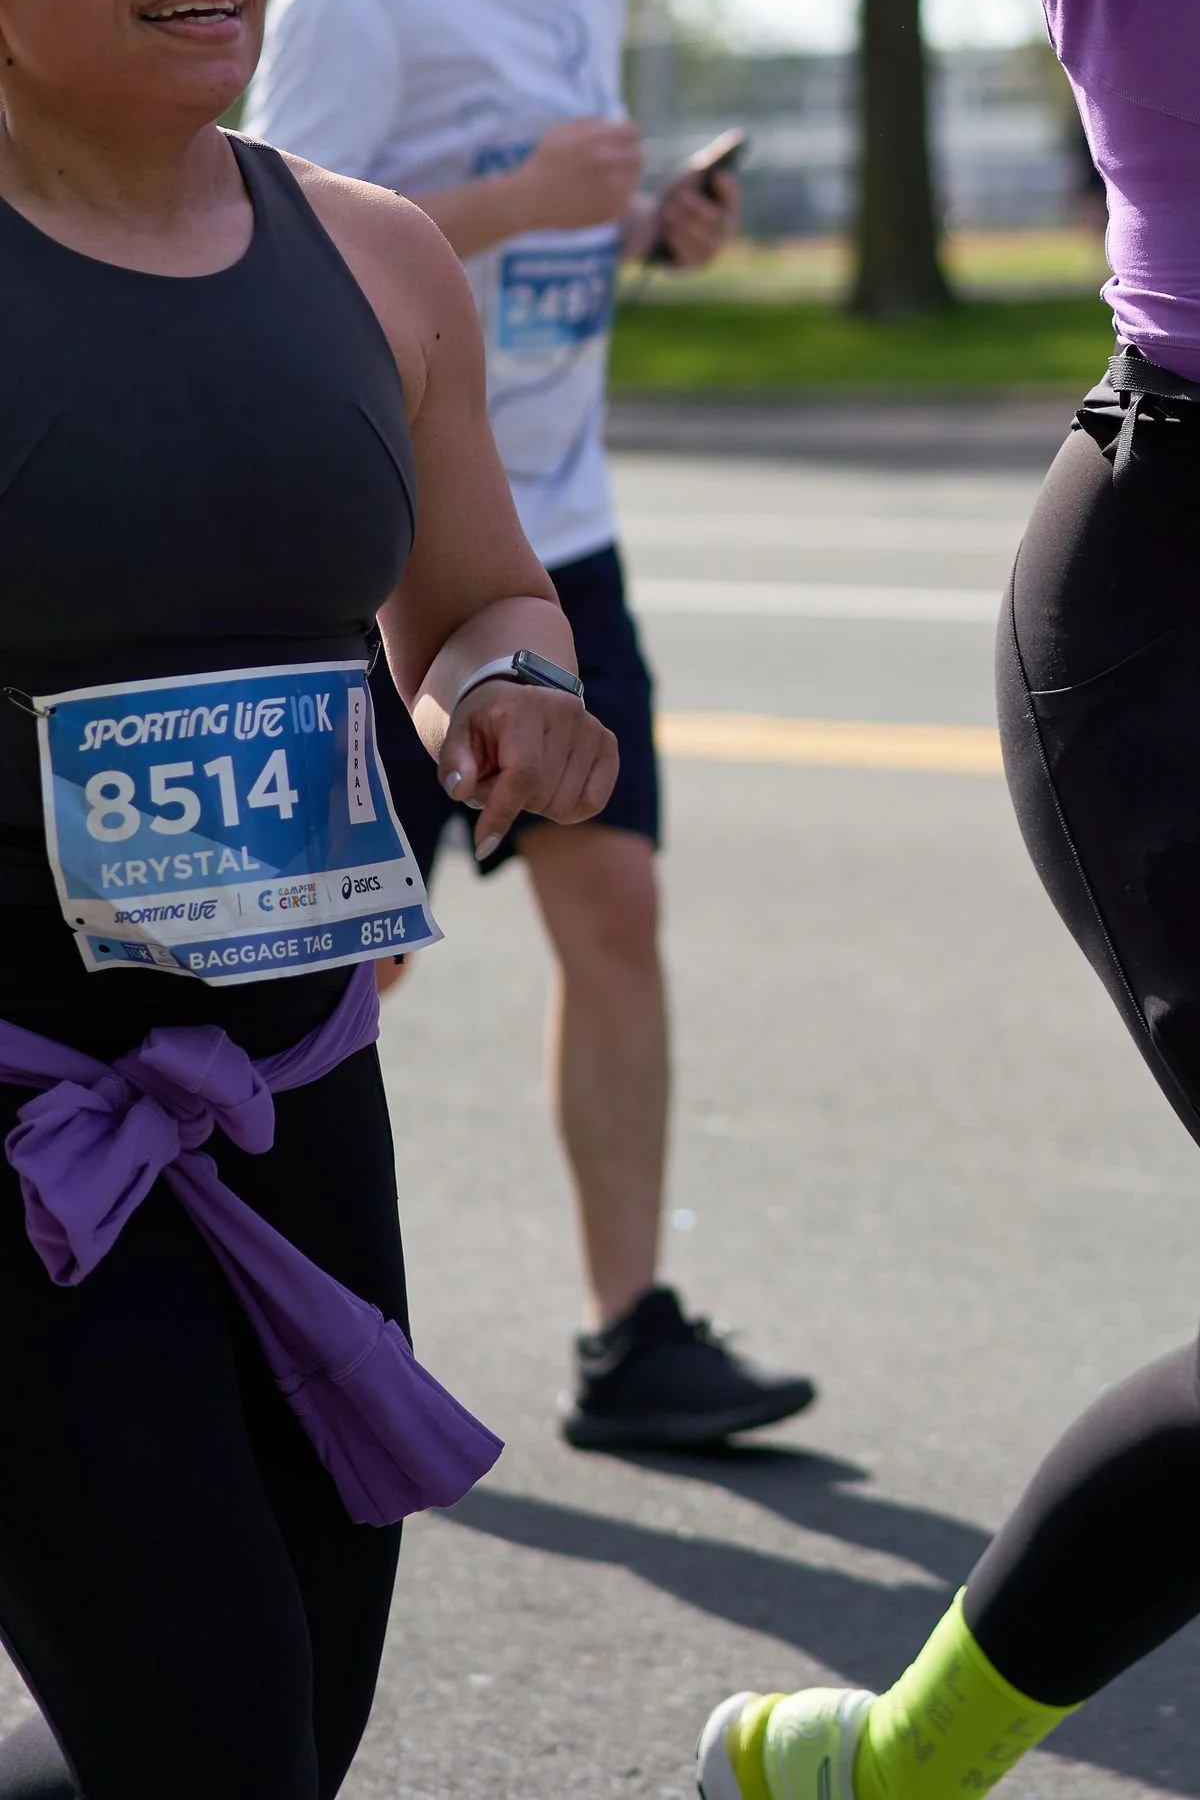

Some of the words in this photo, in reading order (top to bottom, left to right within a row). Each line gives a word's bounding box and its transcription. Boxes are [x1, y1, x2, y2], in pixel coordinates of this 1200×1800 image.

[290, 693, 333, 734] 10K
[353, 702, 364, 807] CORRAL
[85, 748, 299, 842] 8514
[101, 846, 260, 889] KRYSTAL
[279, 893, 318, 910] CIRCLE
[189, 937, 299, 970] BAGGAGE
[304, 932, 334, 954] TAG
[361, 915, 406, 946] 8514
